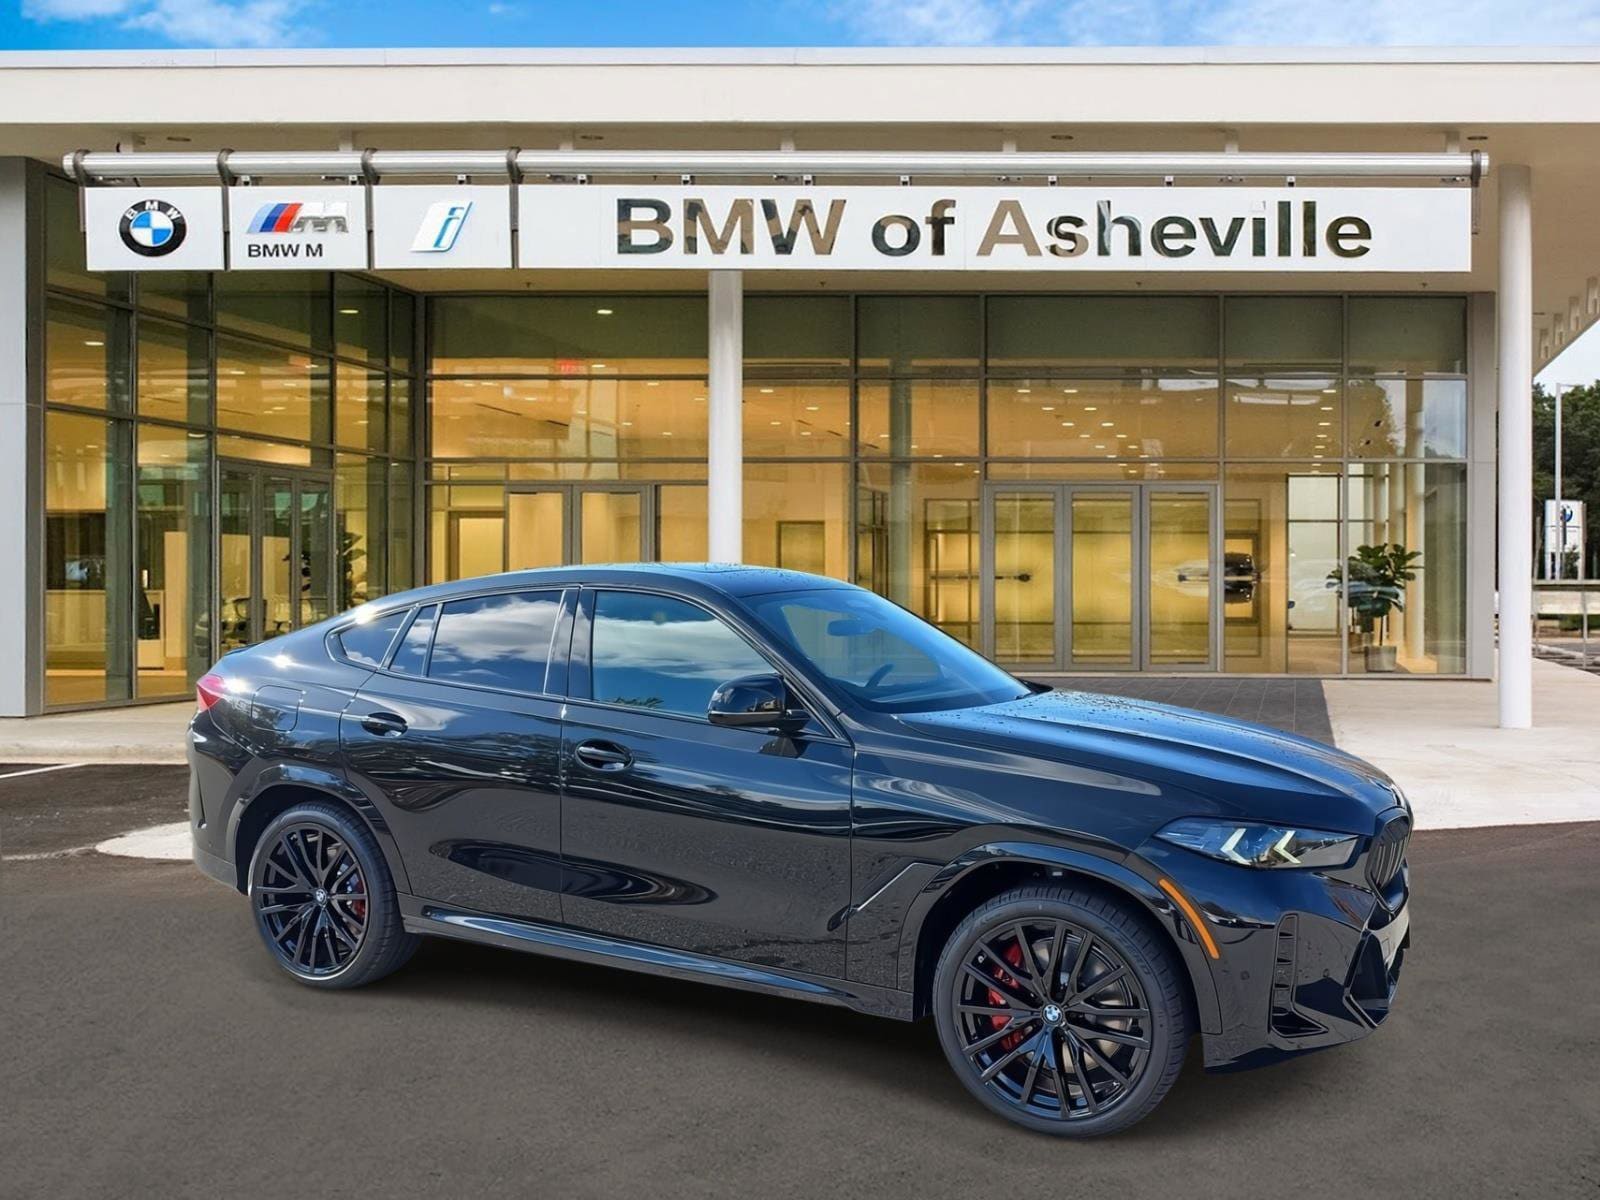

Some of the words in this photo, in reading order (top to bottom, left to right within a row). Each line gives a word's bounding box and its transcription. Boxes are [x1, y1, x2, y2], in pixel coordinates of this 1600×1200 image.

[124, 200, 182, 221] BMW
[617, 198, 847, 256] BMW
[871, 197, 956, 258] of
[976, 198, 1372, 259] Asheville
[247, 244, 301, 258] BMW
[305, 244, 323, 258] M
